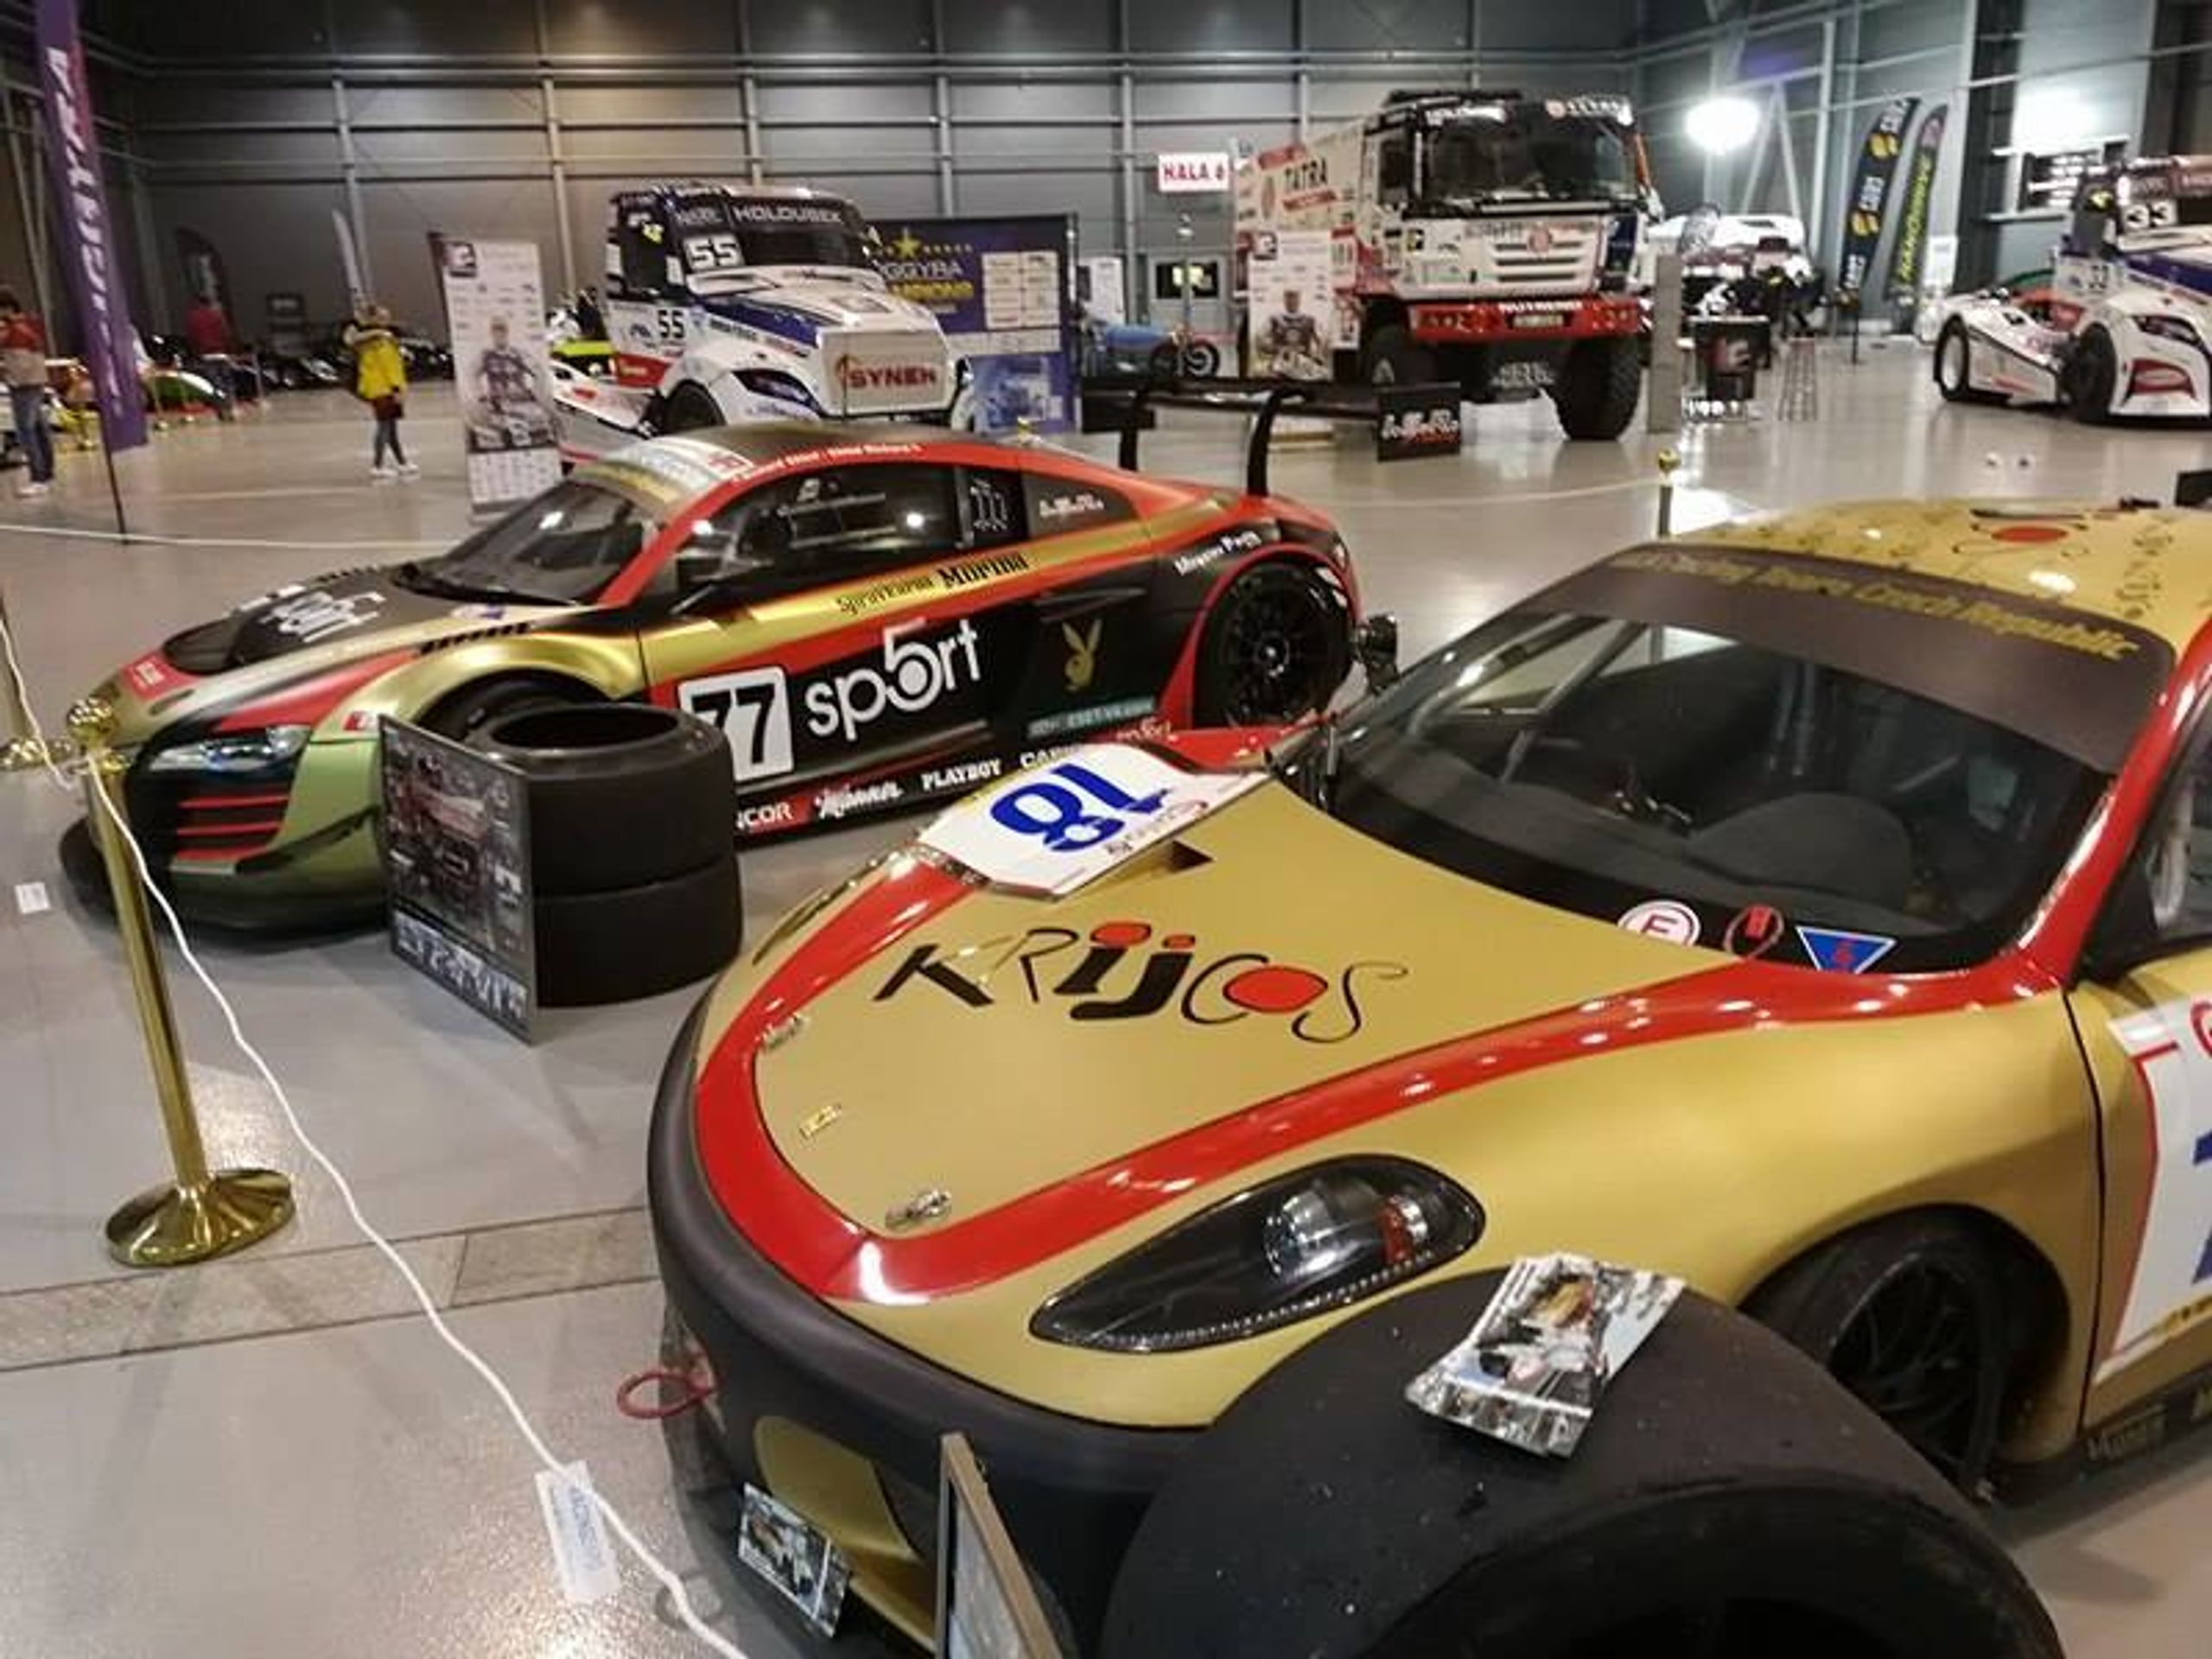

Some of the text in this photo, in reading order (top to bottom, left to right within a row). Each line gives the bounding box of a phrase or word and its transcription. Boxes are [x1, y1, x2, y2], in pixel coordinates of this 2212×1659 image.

[1164, 162, 1211, 181] HALA
[2126, 200, 2175, 228] 33
[690, 236, 737, 267] 55
[658, 309, 684, 338] 55
[692, 682, 778, 765] 77
[921, 759, 1002, 791] PLAYBOY
